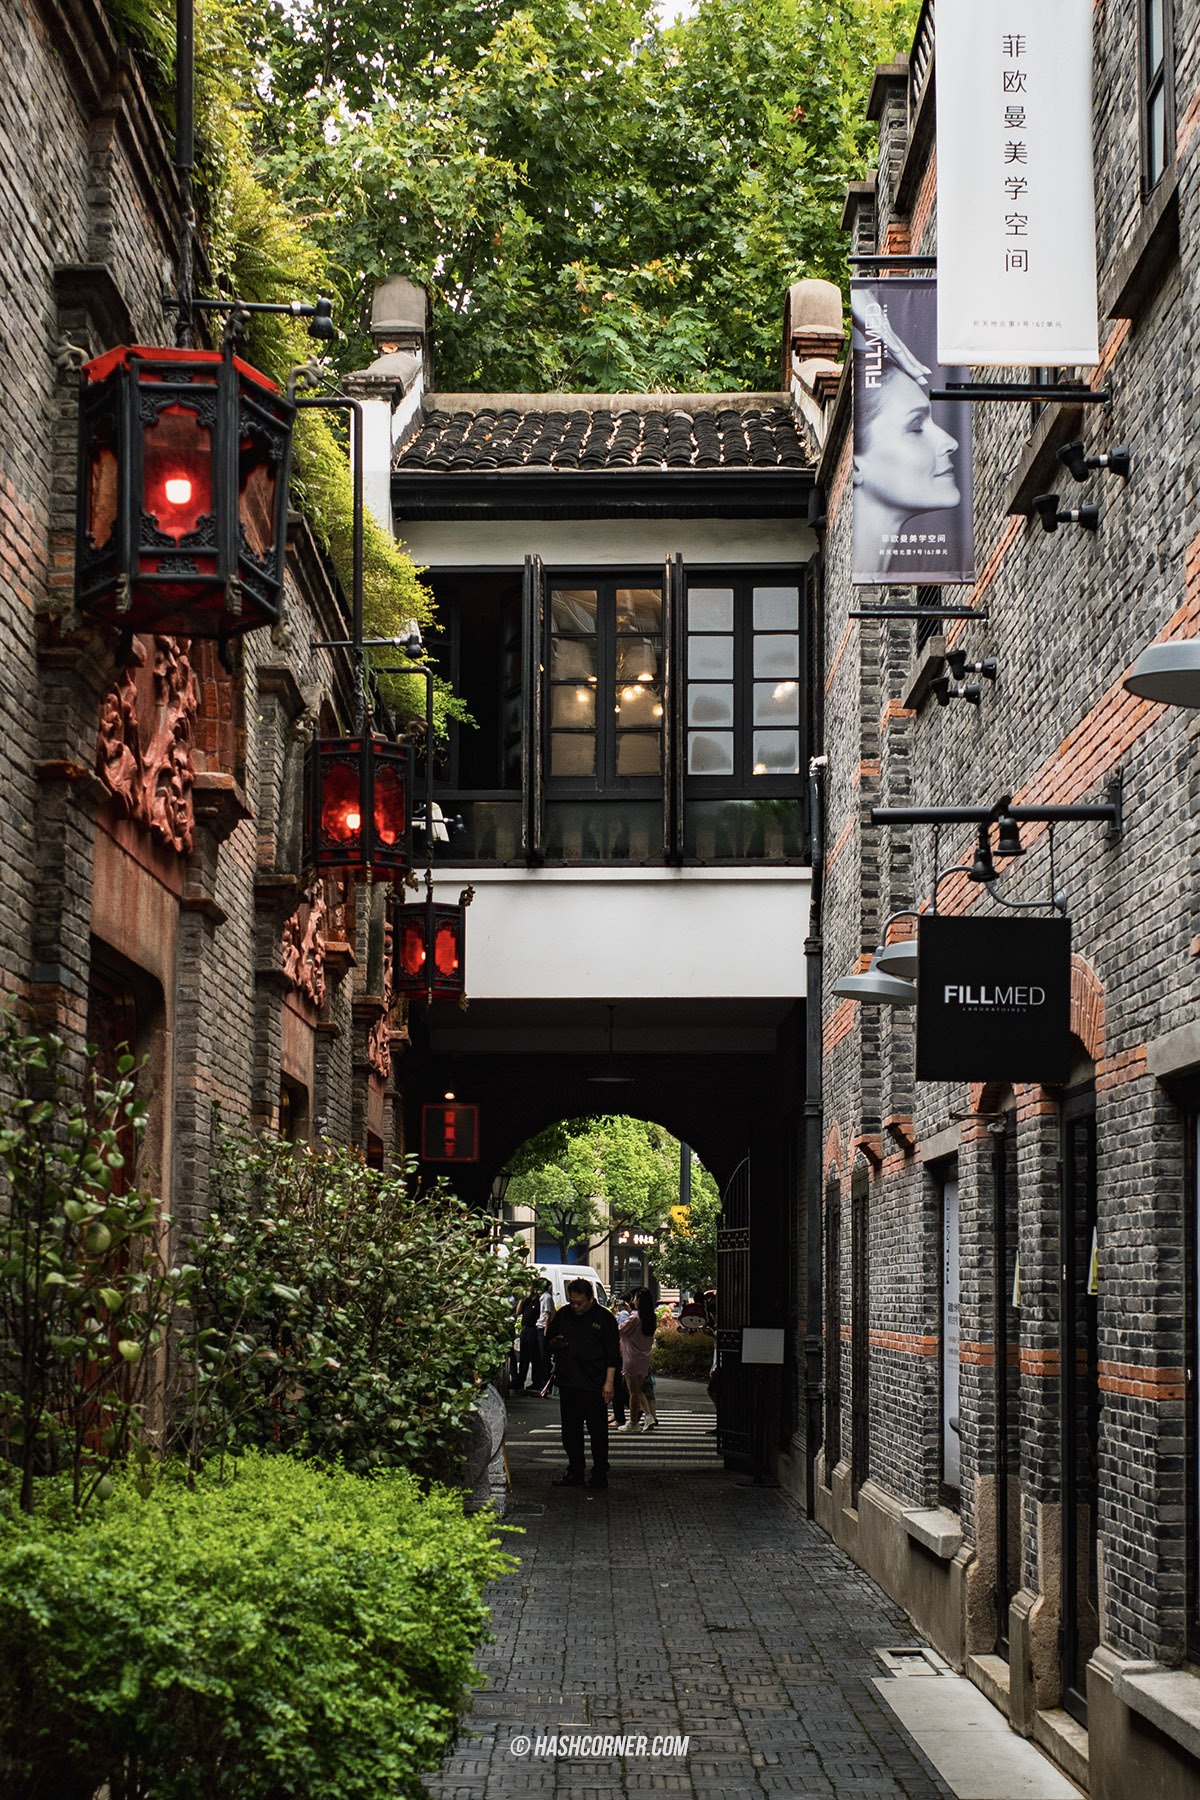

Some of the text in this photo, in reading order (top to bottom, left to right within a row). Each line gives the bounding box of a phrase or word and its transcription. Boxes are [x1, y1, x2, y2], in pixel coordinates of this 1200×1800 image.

[1001, 33, 1029, 273] 菲欧曼美学空间
[865, 303, 882, 389] FILLMED
[944, 985, 1046, 1005] FILLMED
